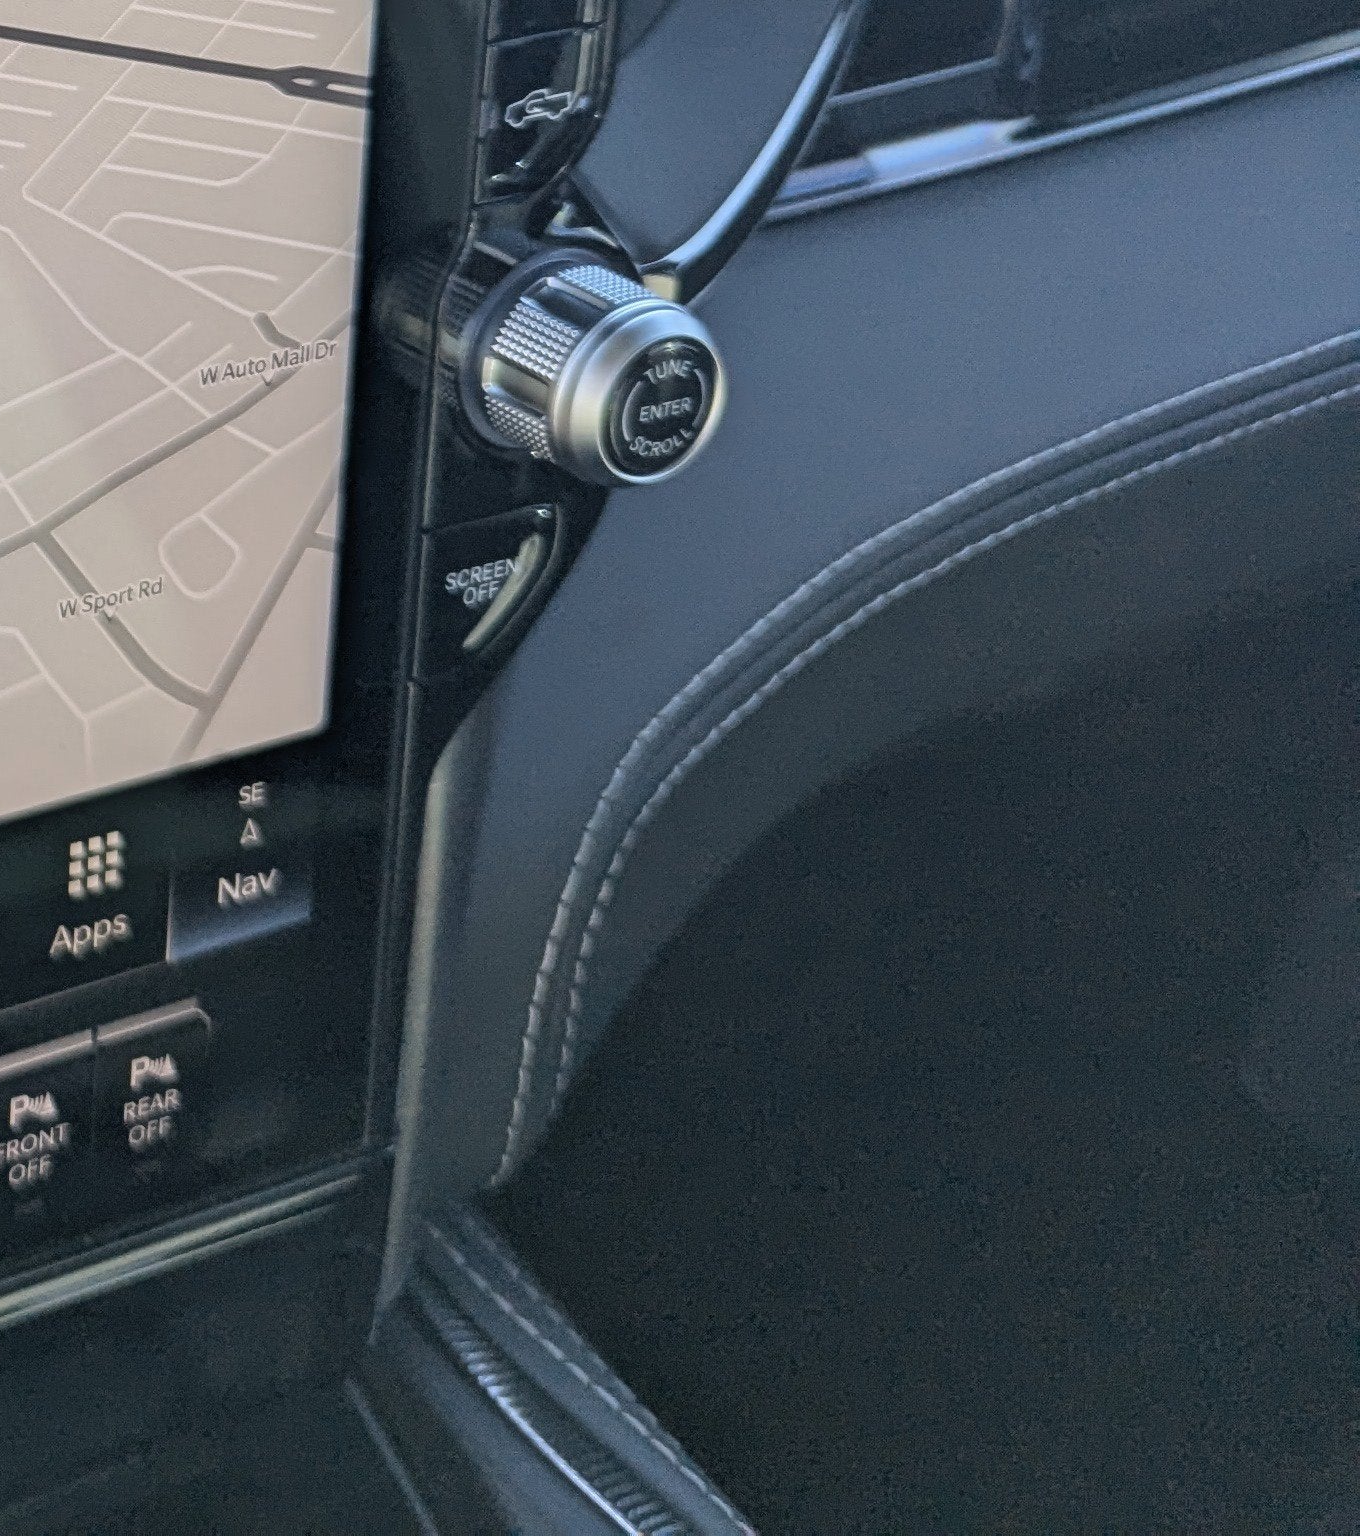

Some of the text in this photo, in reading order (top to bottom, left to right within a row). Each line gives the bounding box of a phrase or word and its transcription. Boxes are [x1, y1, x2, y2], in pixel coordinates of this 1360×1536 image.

[199, 339, 338, 386] W Auto Mall Dr
[642, 359, 692, 385] TUNE
[639, 396, 693, 422] ENTER
[628, 427, 694, 457] SCROLL
[444, 557, 521, 595] SCREEN
[58, 577, 164, 620] W Sport Rd
[461, 581, 501, 609] OFF
[237, 781, 267, 808] SE
[216, 868, 279, 906] Nav
[49, 910, 132, 959] Apps
[123, 1088, 181, 1124] REAR
[127, 1115, 172, 1150] OFF
[8, 1154, 53, 1190] OFF
